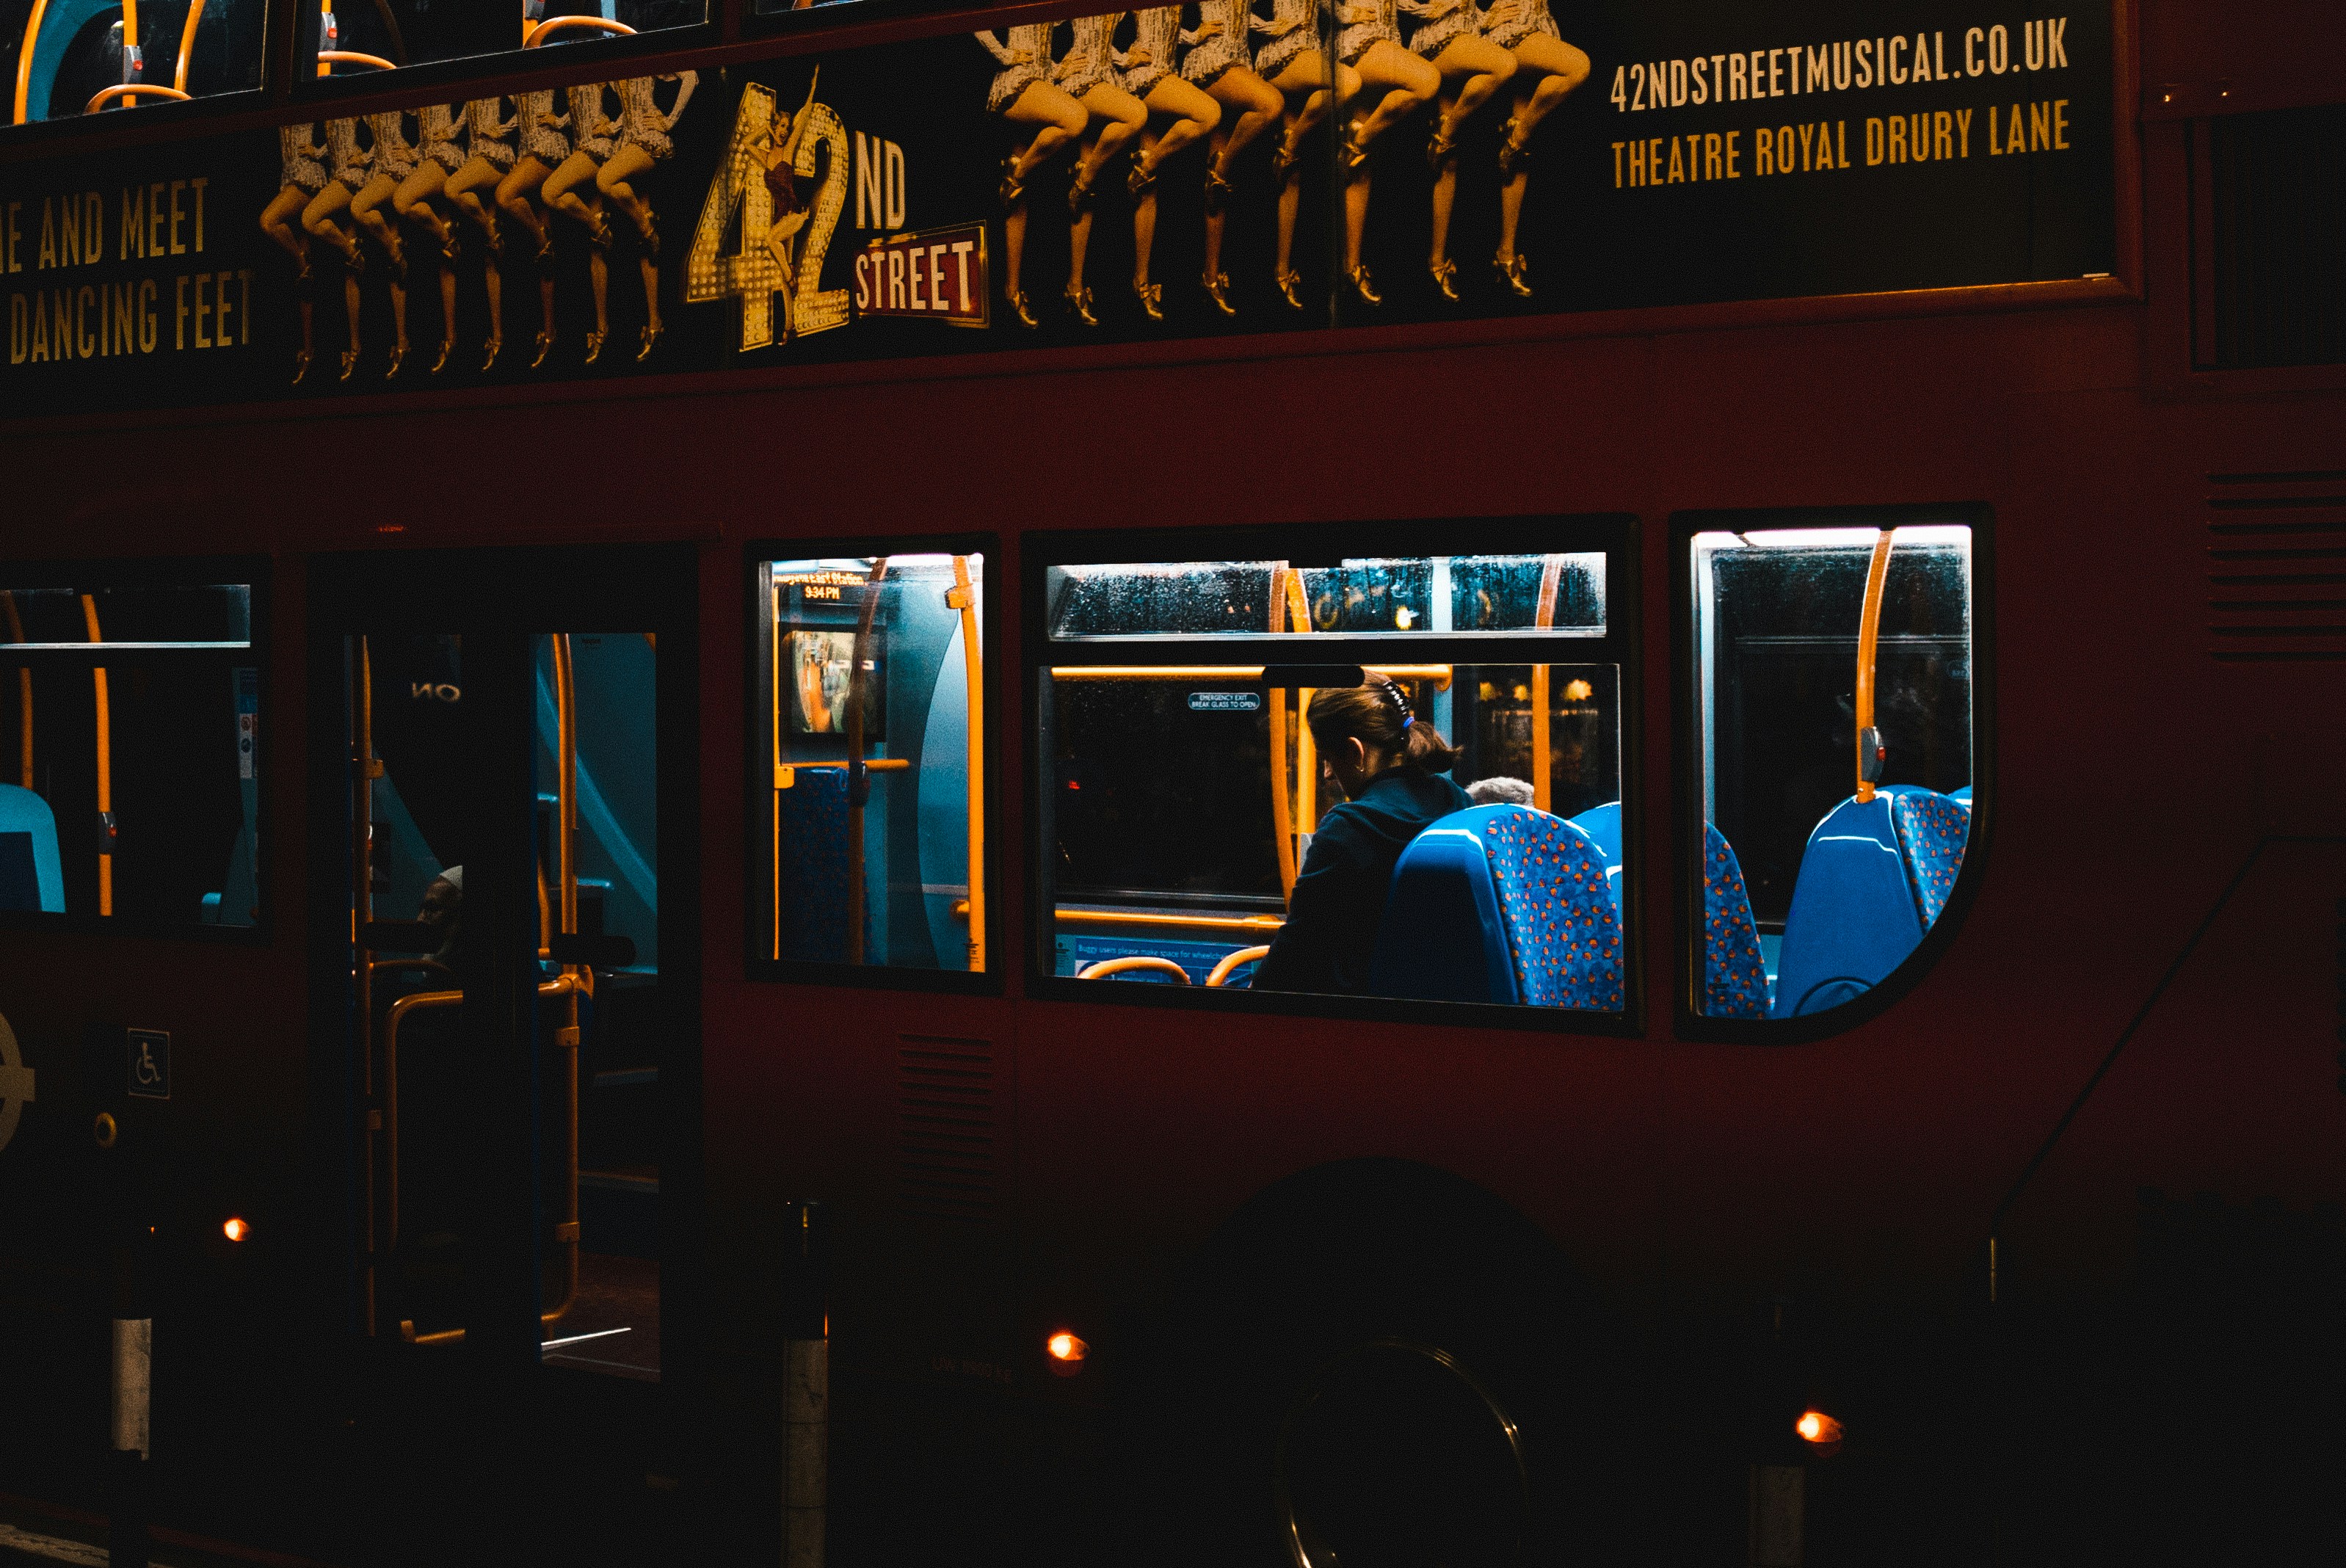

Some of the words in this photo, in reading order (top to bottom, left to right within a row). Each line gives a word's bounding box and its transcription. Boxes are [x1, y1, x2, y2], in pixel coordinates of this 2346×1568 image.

[1610, 17, 2069, 112] 42NDSTREETMUSICAL.CO.UK
[1612, 130, 1740, 188] THEATRE
[1756, 120, 1851, 176] ROYAL
[1867, 108, 1972, 166] DRURY
[1989, 99, 2070, 155] LANE
[0, 202, 23, 274] E
[38, 191, 103, 269] AND
[120, 177, 209, 260] MEET
[686, 81, 849, 352] 42
[10, 278, 158, 364] DANCING
[175, 269, 253, 350] FEET
[855, 240, 973, 311] STREET
[1078, 944, 1097, 954] Buggy
[1118, 945, 1138, 956] please
[1160, 951, 1179, 959] space
[1180, 950, 1190, 958] for
